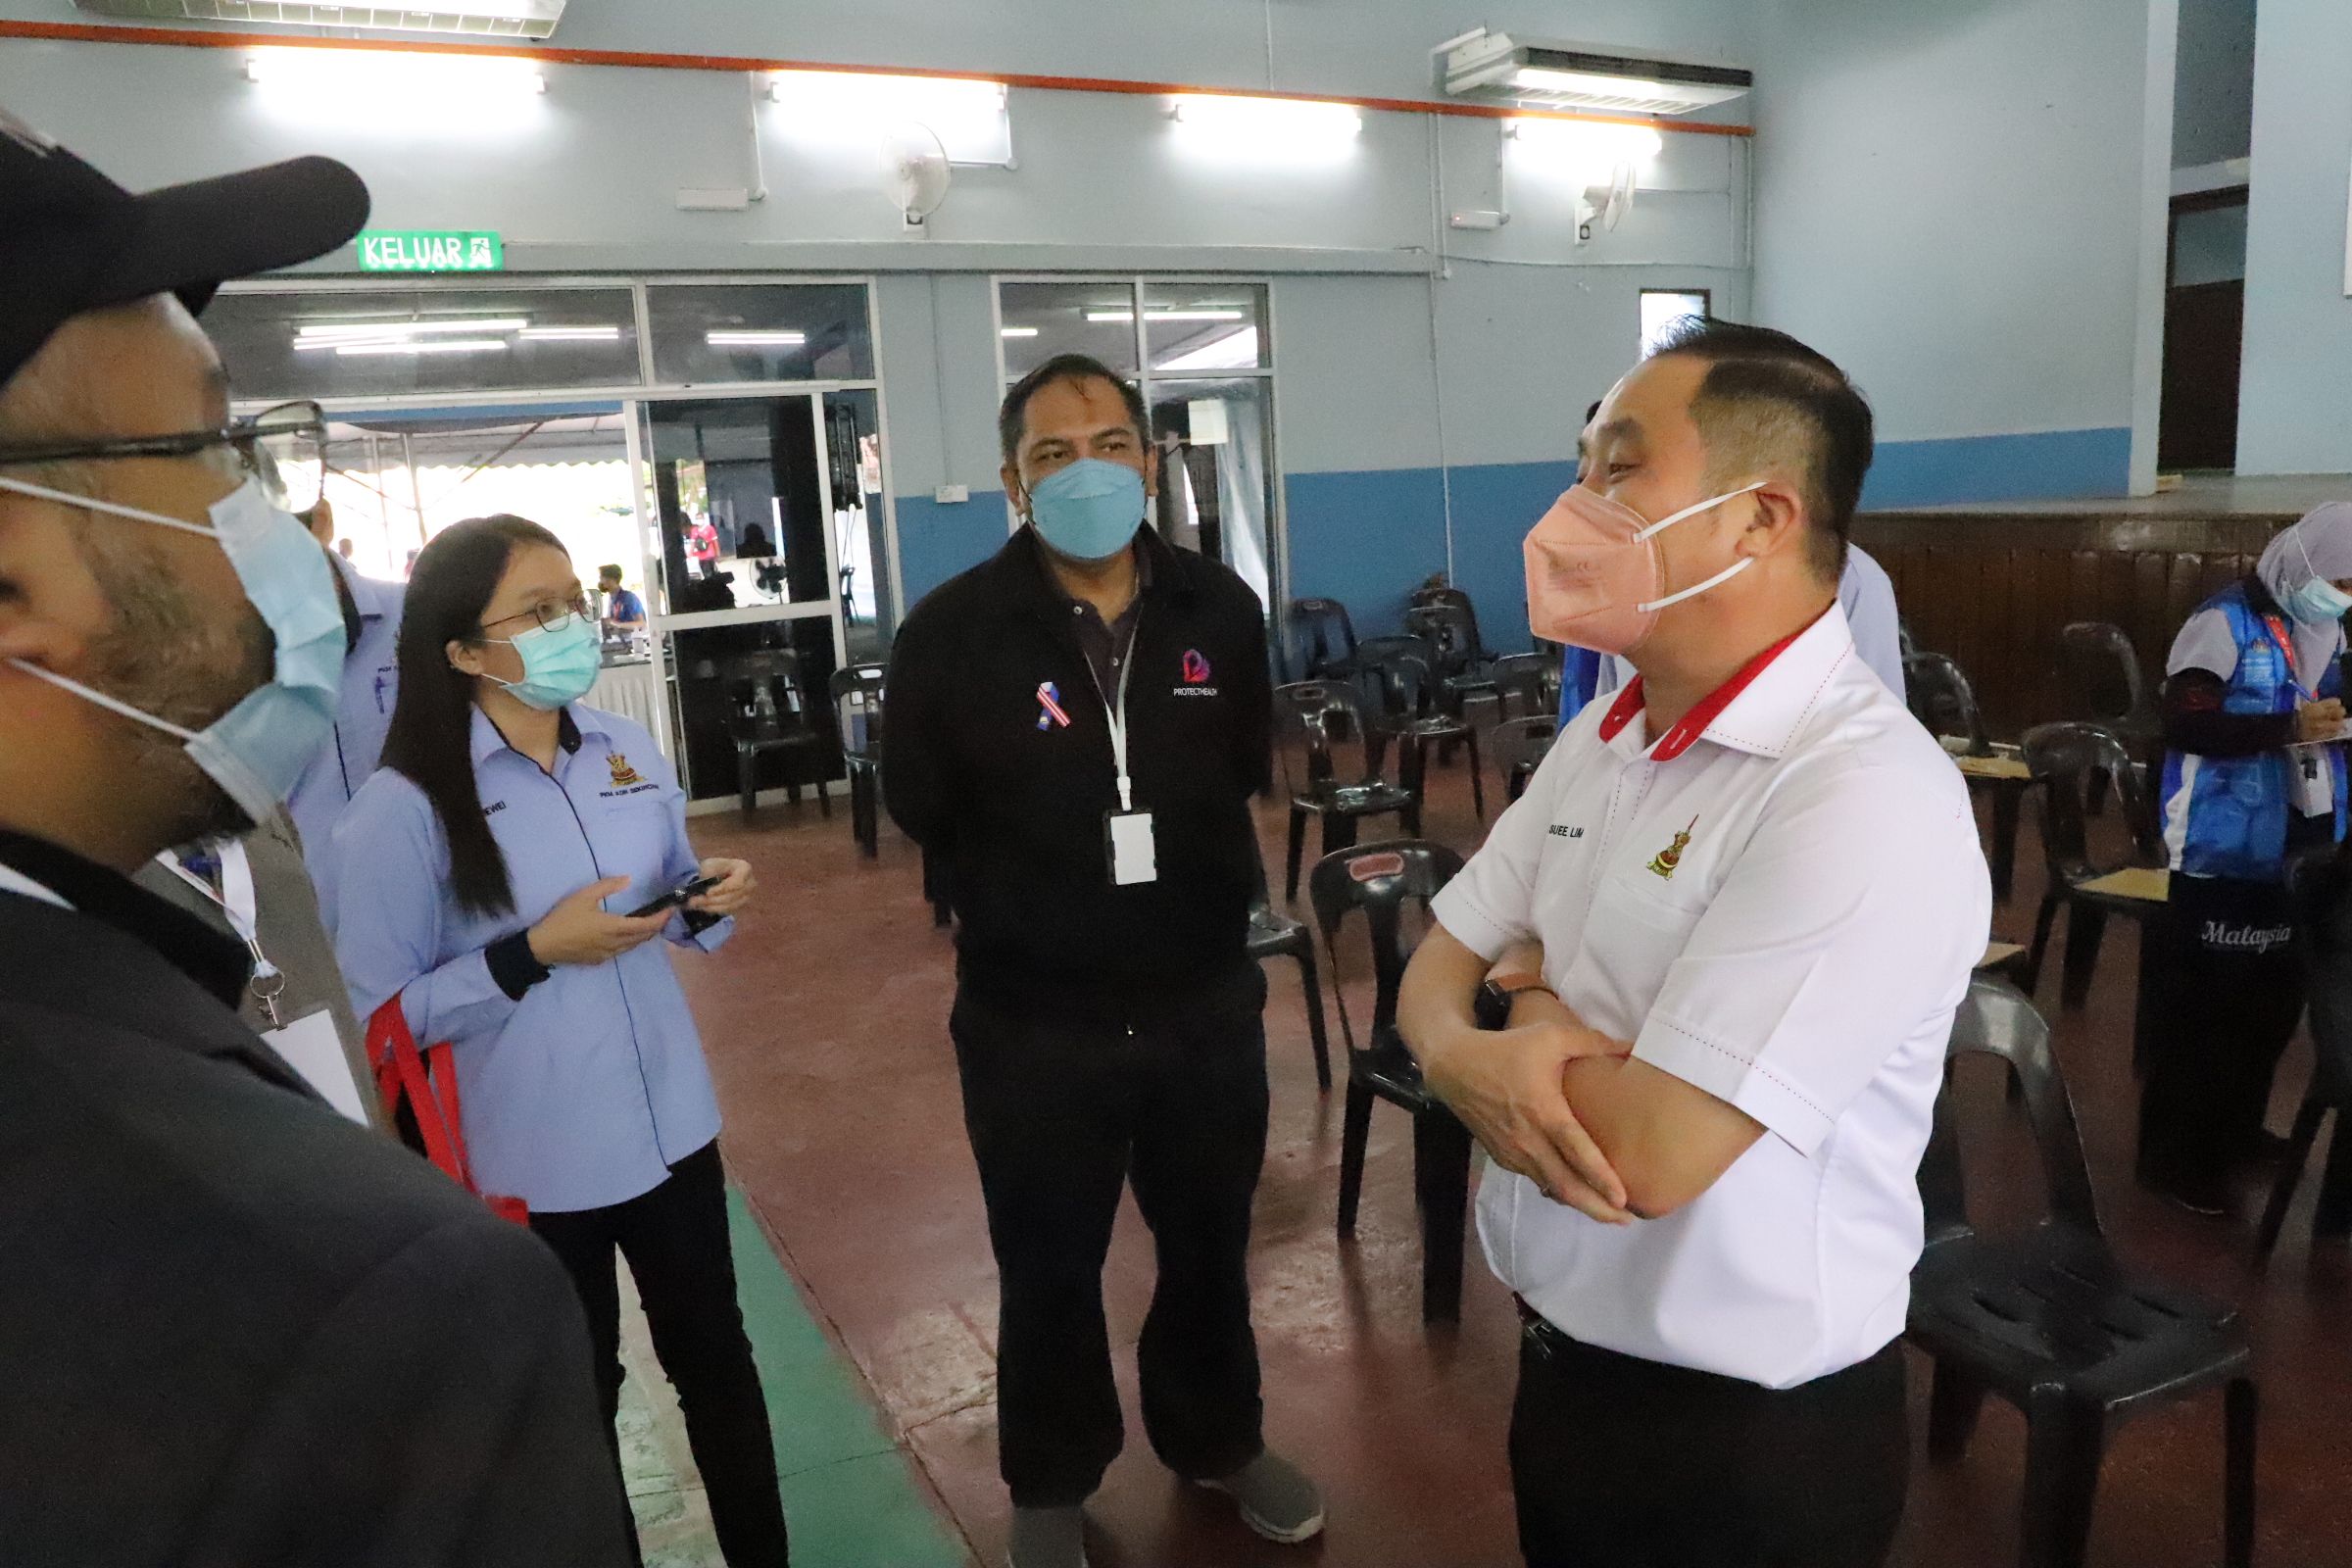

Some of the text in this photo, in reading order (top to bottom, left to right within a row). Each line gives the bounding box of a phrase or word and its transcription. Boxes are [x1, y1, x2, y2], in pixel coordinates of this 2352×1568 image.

[364, 236, 464, 267] KELUAR
[1548, 824, 1585, 838] SUEE LIM
[2201, 920, 2291, 955] Malaysia
